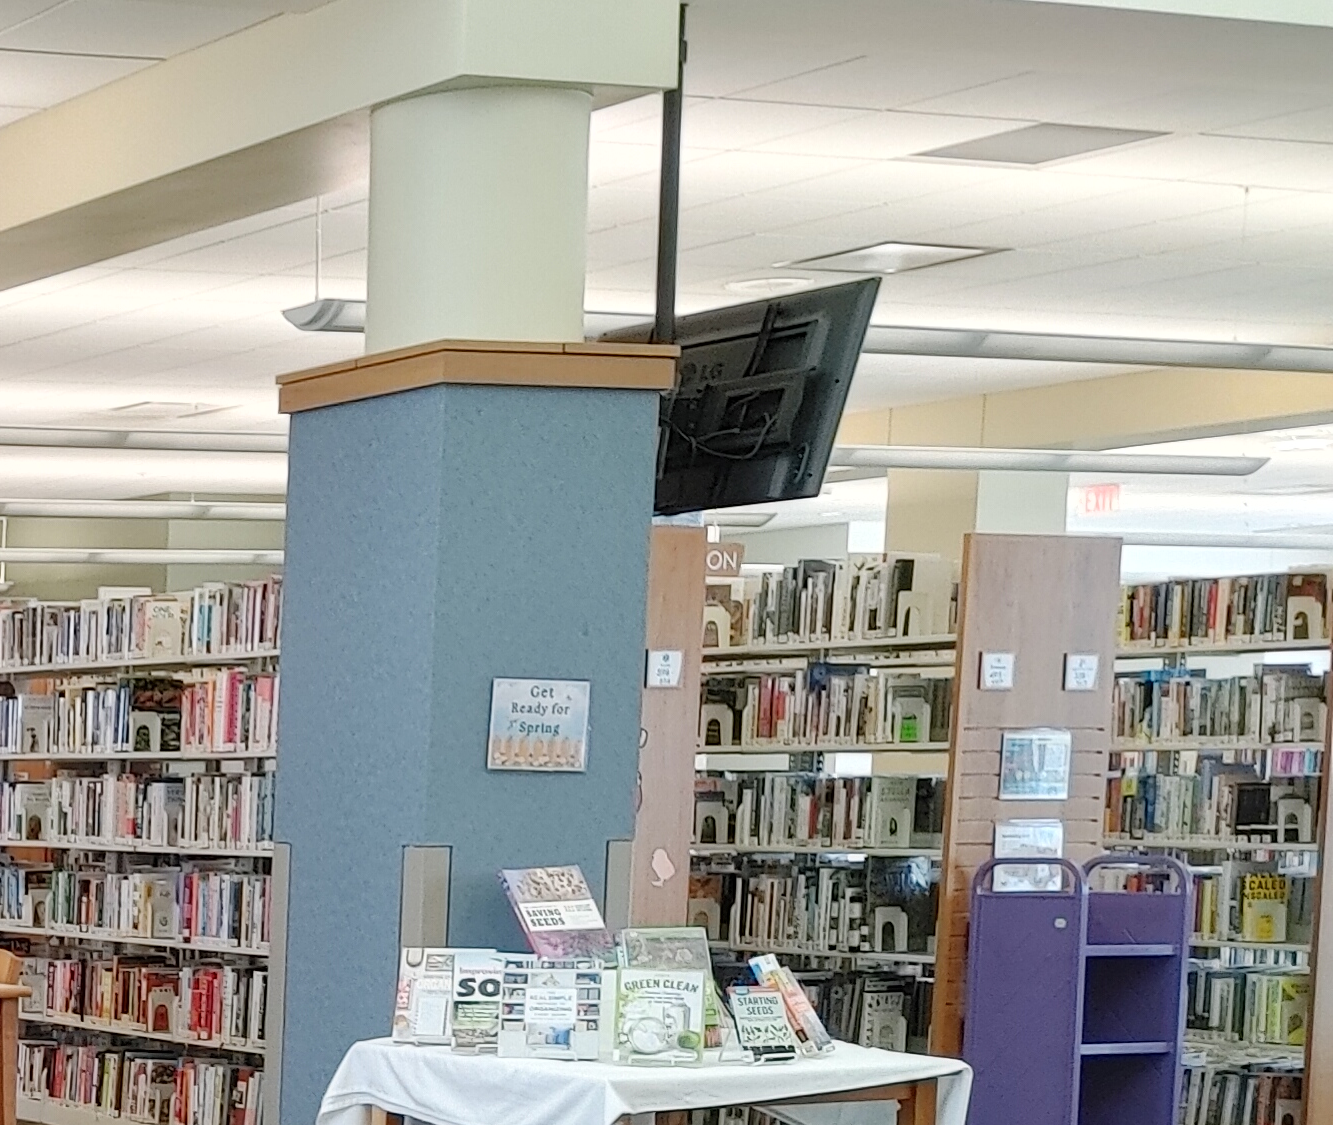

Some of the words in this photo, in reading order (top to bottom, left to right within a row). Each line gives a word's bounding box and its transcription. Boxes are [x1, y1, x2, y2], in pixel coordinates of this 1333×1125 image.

[1085, 490, 1114, 513] EXIT
[530, 685, 555, 699] Get
[511, 702, 549, 717] Ready
[551, 703, 571, 715] for
[518, 721, 560, 737] Spring
[530, 917, 565, 927] SEEDS
[457, 977, 501, 997] SO
[623, 978, 661, 991] GREEN
[664, 979, 699, 993] CLEAN
[737, 996, 779, 1006] STARTING
[746, 1007, 774, 1016] SEEDS
